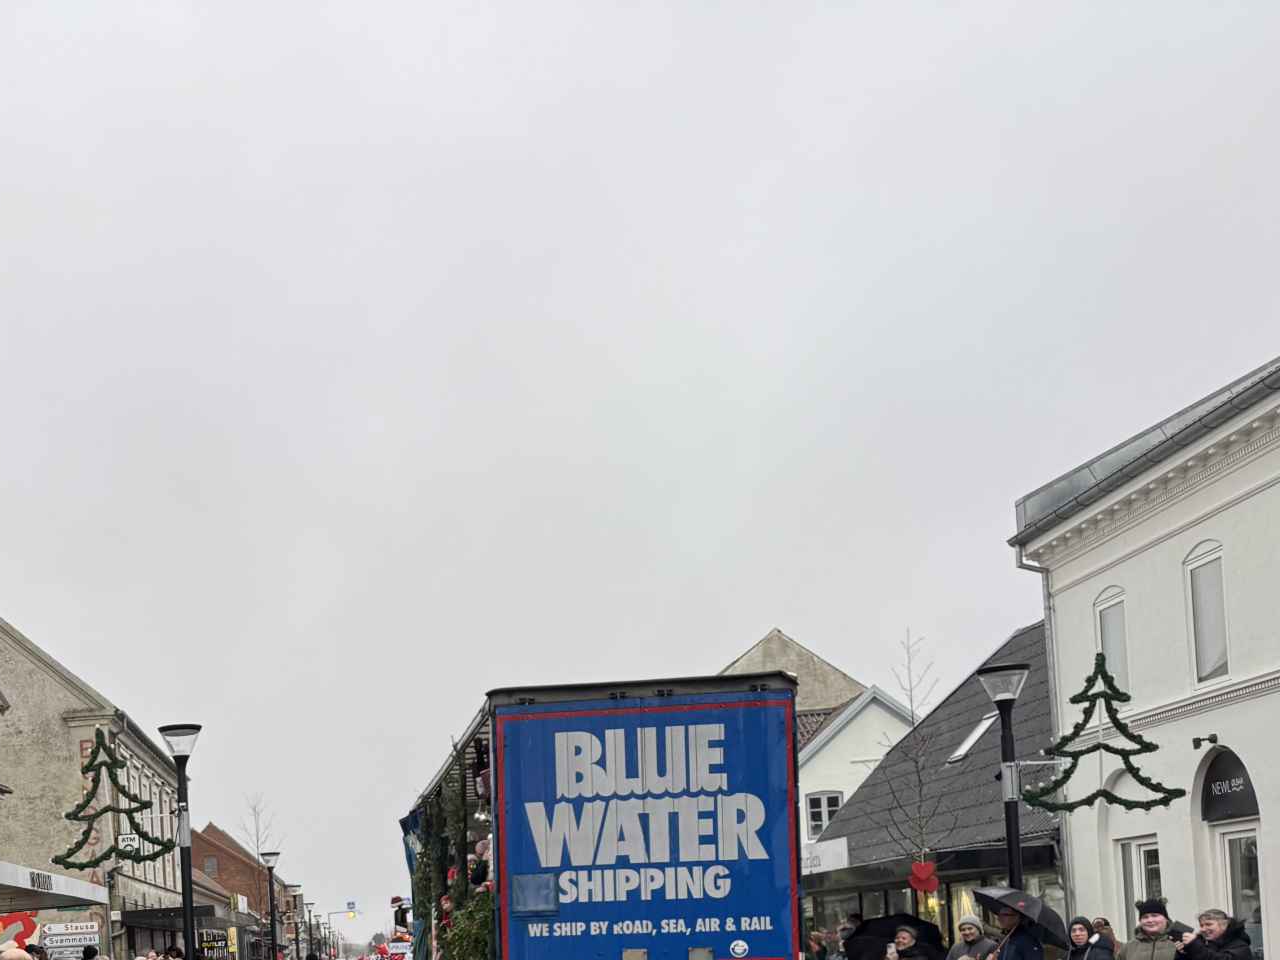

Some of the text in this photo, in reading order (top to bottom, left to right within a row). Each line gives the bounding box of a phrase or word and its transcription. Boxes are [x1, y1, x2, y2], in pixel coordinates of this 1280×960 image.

[554, 723, 728, 800] BLUE
[524, 793, 769, 868] WATER
[558, 865, 732, 903] SHIPPING
[528, 916, 774, 937] WE SHIP BY ROAD, SEA, AIR & RAIL
